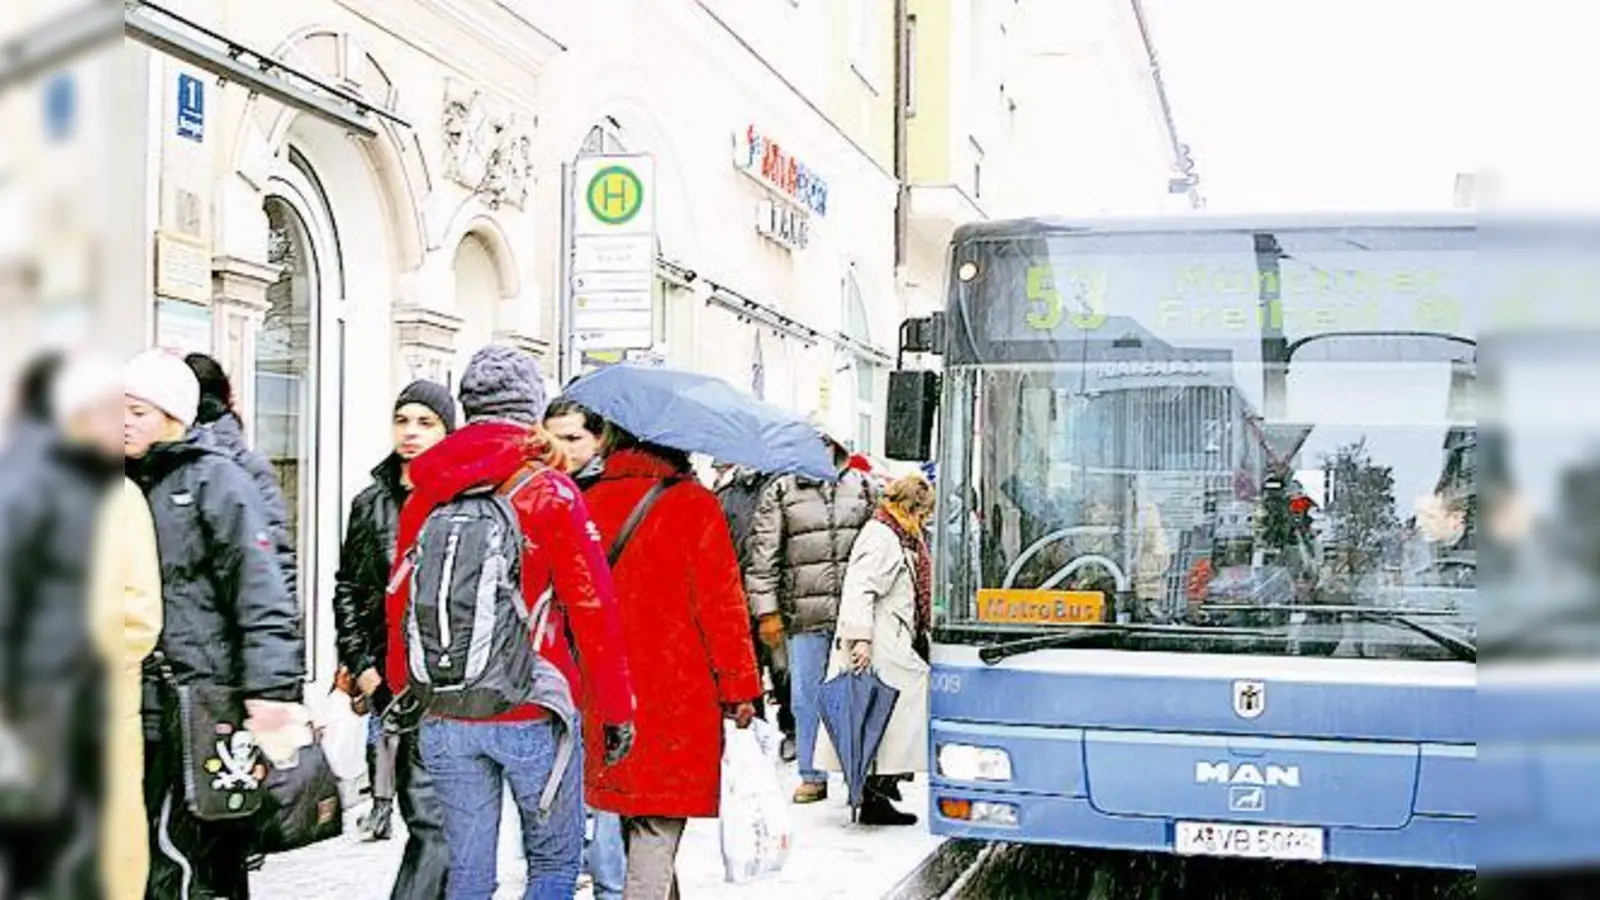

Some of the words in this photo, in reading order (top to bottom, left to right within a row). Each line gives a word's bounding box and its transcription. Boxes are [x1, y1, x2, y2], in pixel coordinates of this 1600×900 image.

[187, 80, 196, 109] 1
[604, 178, 627, 213] H
[1026, 266, 1109, 330] 53
[1195, 761, 1301, 787] MAN
